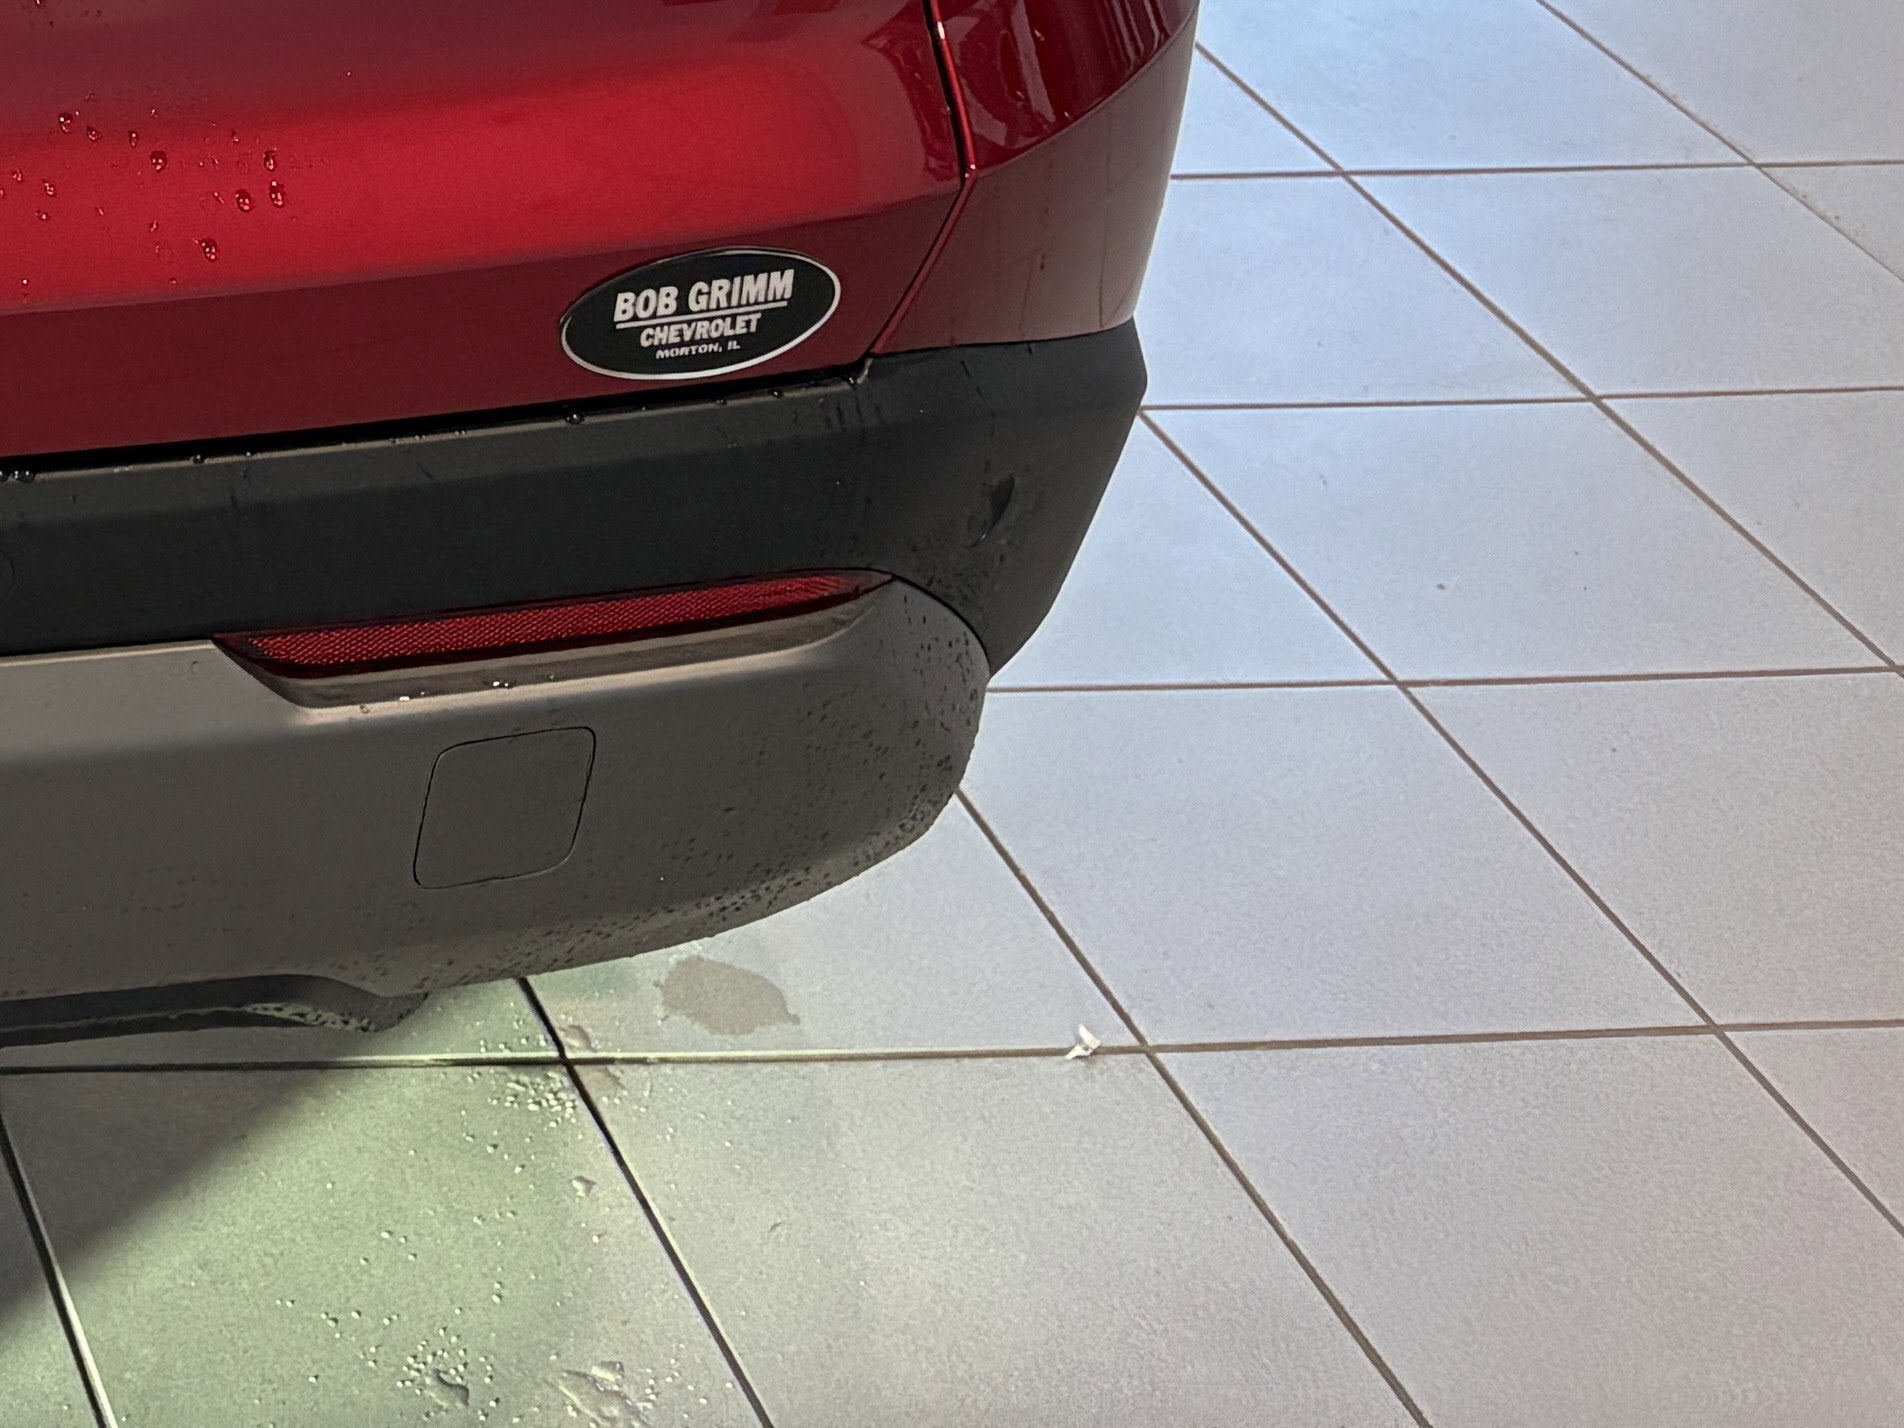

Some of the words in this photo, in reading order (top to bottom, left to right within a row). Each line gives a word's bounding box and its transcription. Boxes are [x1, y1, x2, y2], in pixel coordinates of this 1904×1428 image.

[613, 285, 679, 322] BOB
[688, 269, 795, 311] GRIMM
[640, 312, 762, 348] CHEVROLET
[655, 342, 722, 359] MORTON,
